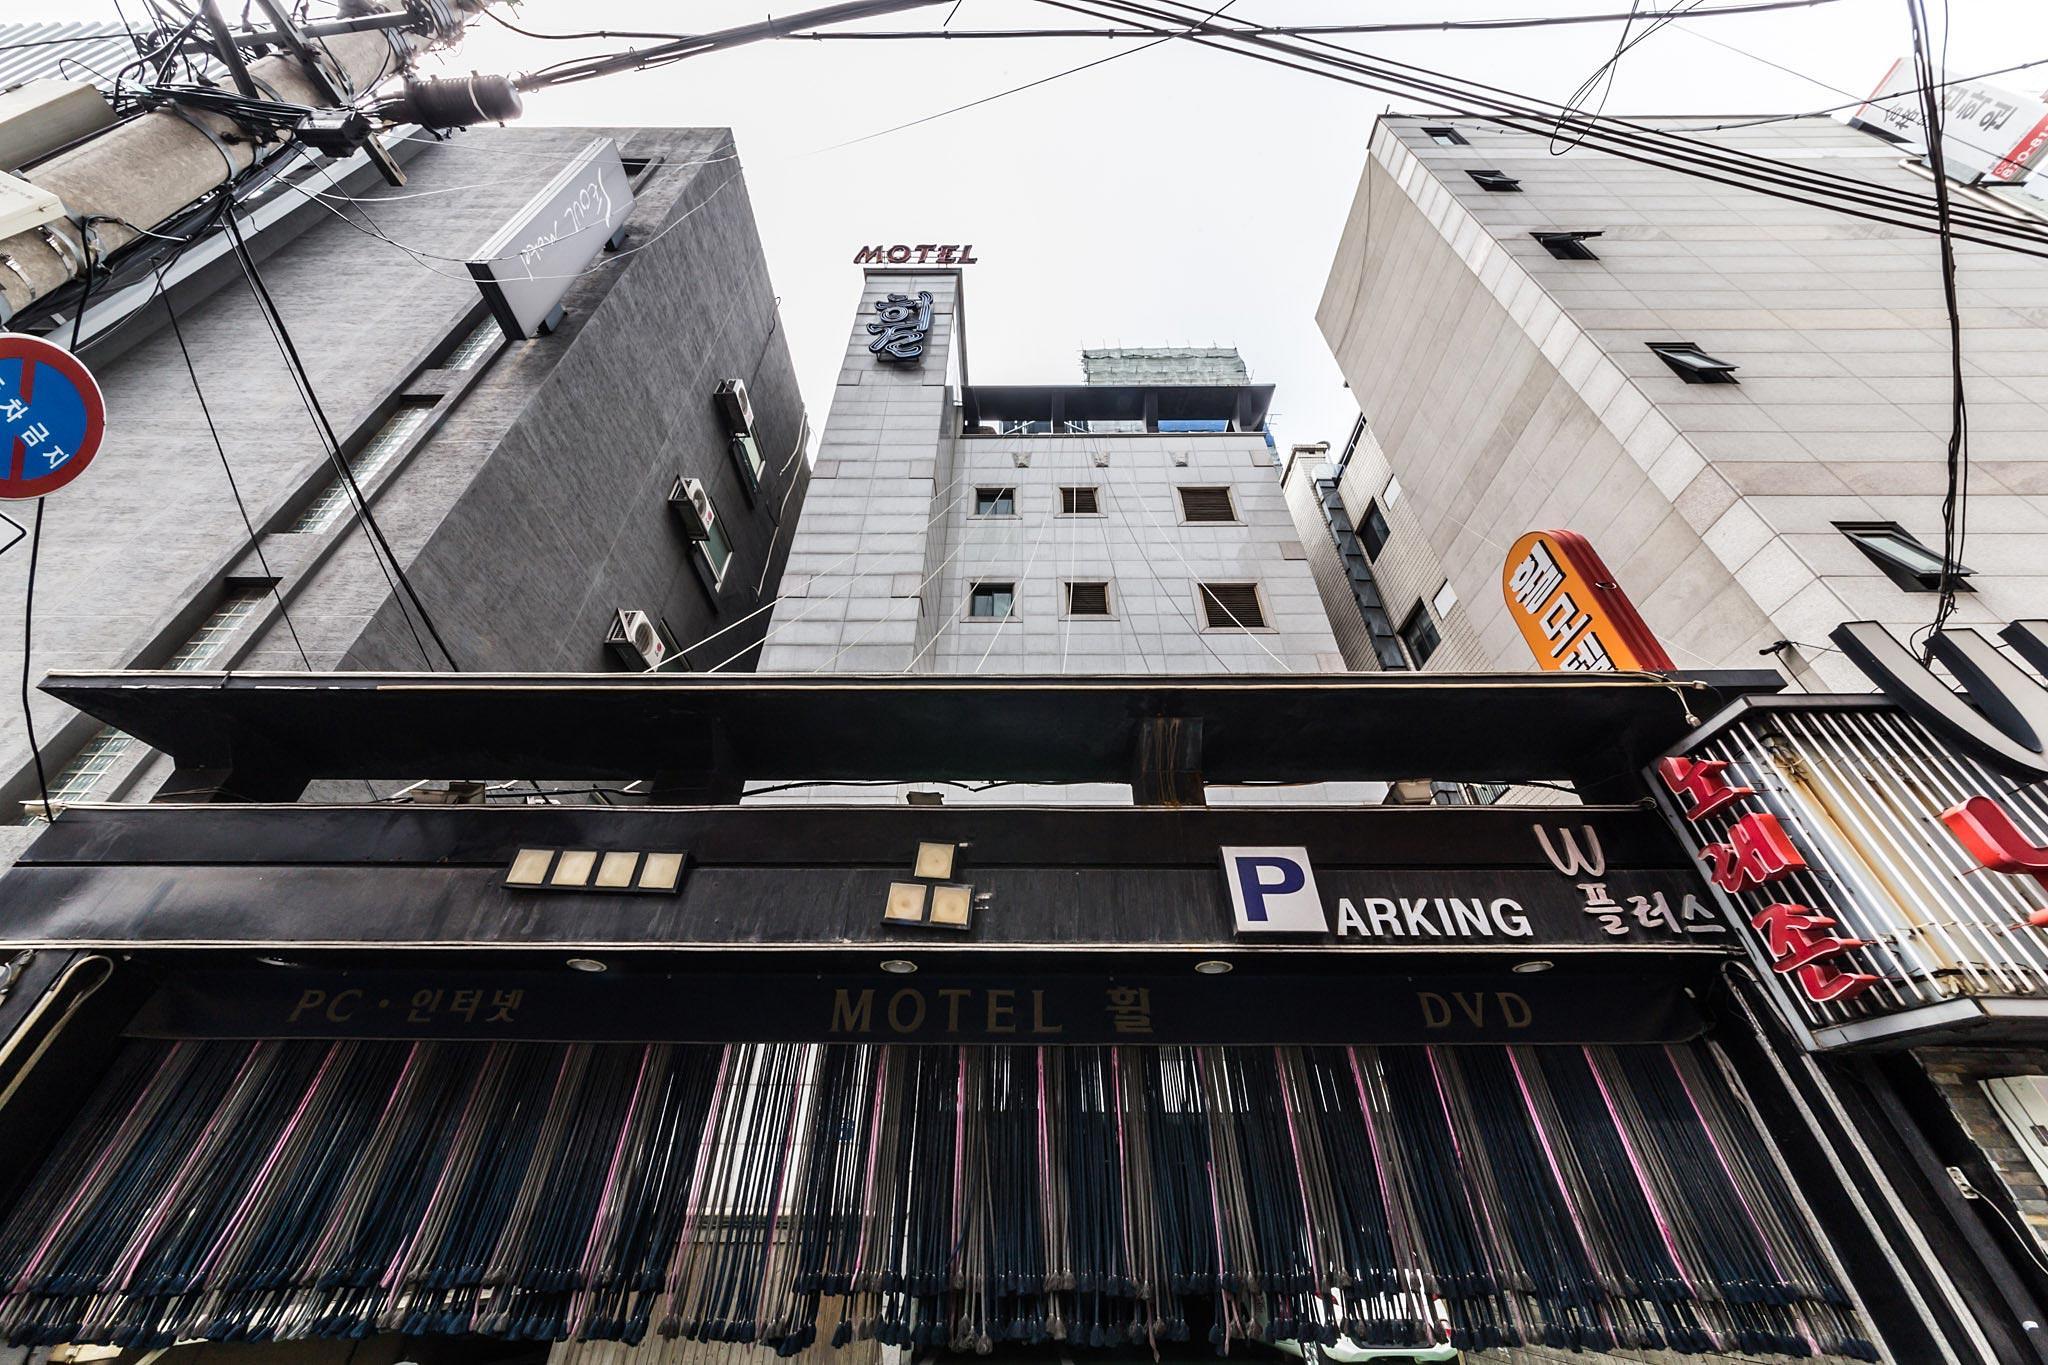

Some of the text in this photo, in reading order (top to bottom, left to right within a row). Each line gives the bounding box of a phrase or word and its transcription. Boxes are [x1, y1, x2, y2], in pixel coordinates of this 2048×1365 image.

[564, 167, 611, 228] SEOUL
[853, 244, 978, 264] MOTEL
[0, 378, 69, 469] 차금지
[1533, 824, 1605, 877] W
[1577, 883, 1726, 935] 플러스
[286, 988, 526, 1023] PC 인터넷
[830, 987, 1063, 1034] MOTEL
[1417, 991, 1533, 1029] DVD
